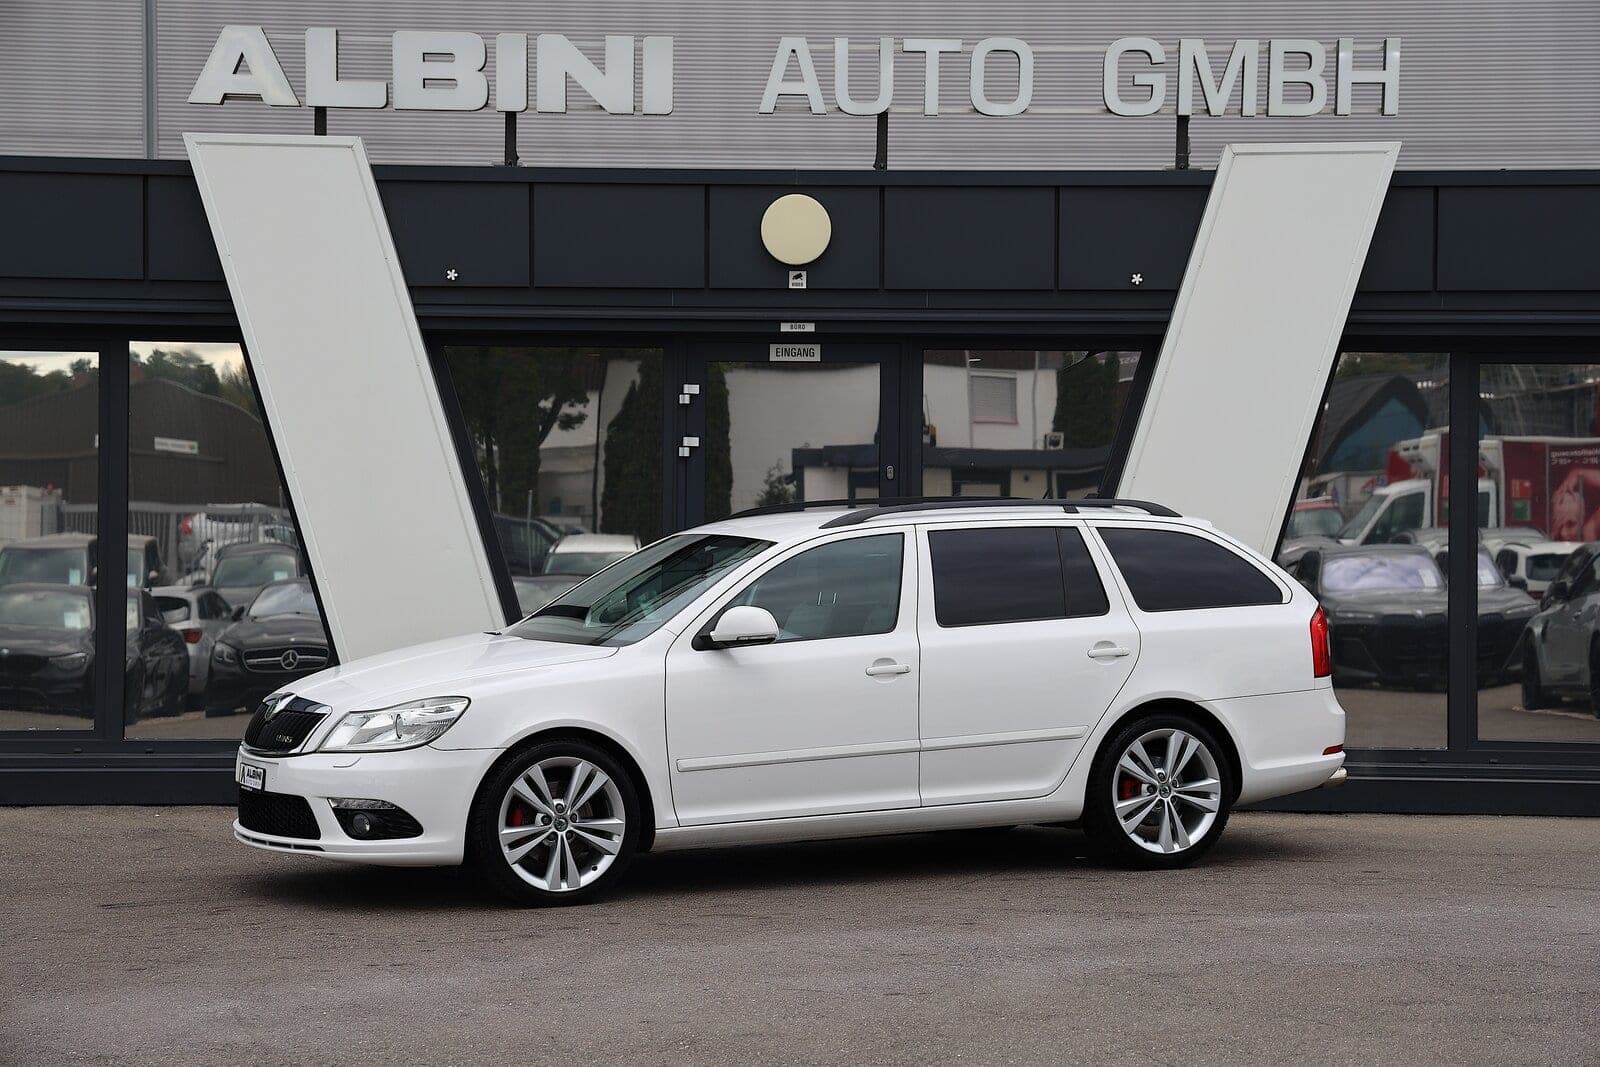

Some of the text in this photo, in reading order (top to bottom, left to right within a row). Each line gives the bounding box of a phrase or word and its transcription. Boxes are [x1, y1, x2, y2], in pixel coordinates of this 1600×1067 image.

[187, 25, 1401, 118] ALBINI AUTO GMBH
[775, 347, 815, 358] EINGANG
